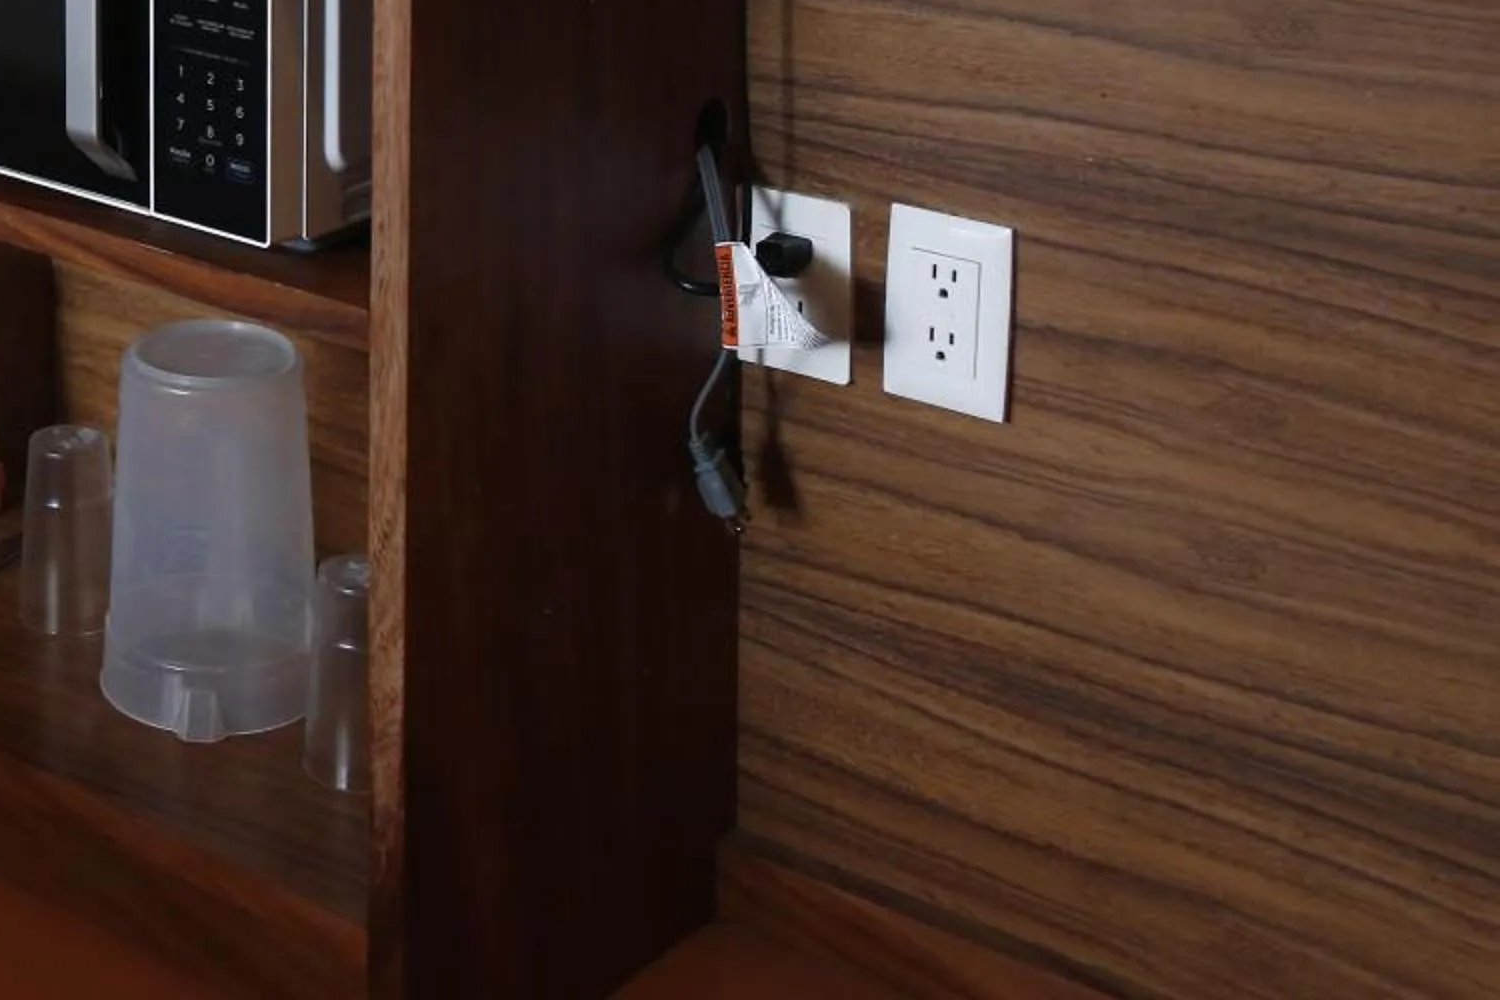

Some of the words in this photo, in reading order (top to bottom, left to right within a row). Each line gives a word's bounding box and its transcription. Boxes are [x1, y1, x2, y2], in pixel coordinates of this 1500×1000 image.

[206, 71, 215, 85] 2
[206, 97, 216, 111] 5
[234, 105, 245, 119] 6
[175, 116, 186, 131] 7
[235, 132, 245, 146] 9
[205, 153, 216, 167] 0
